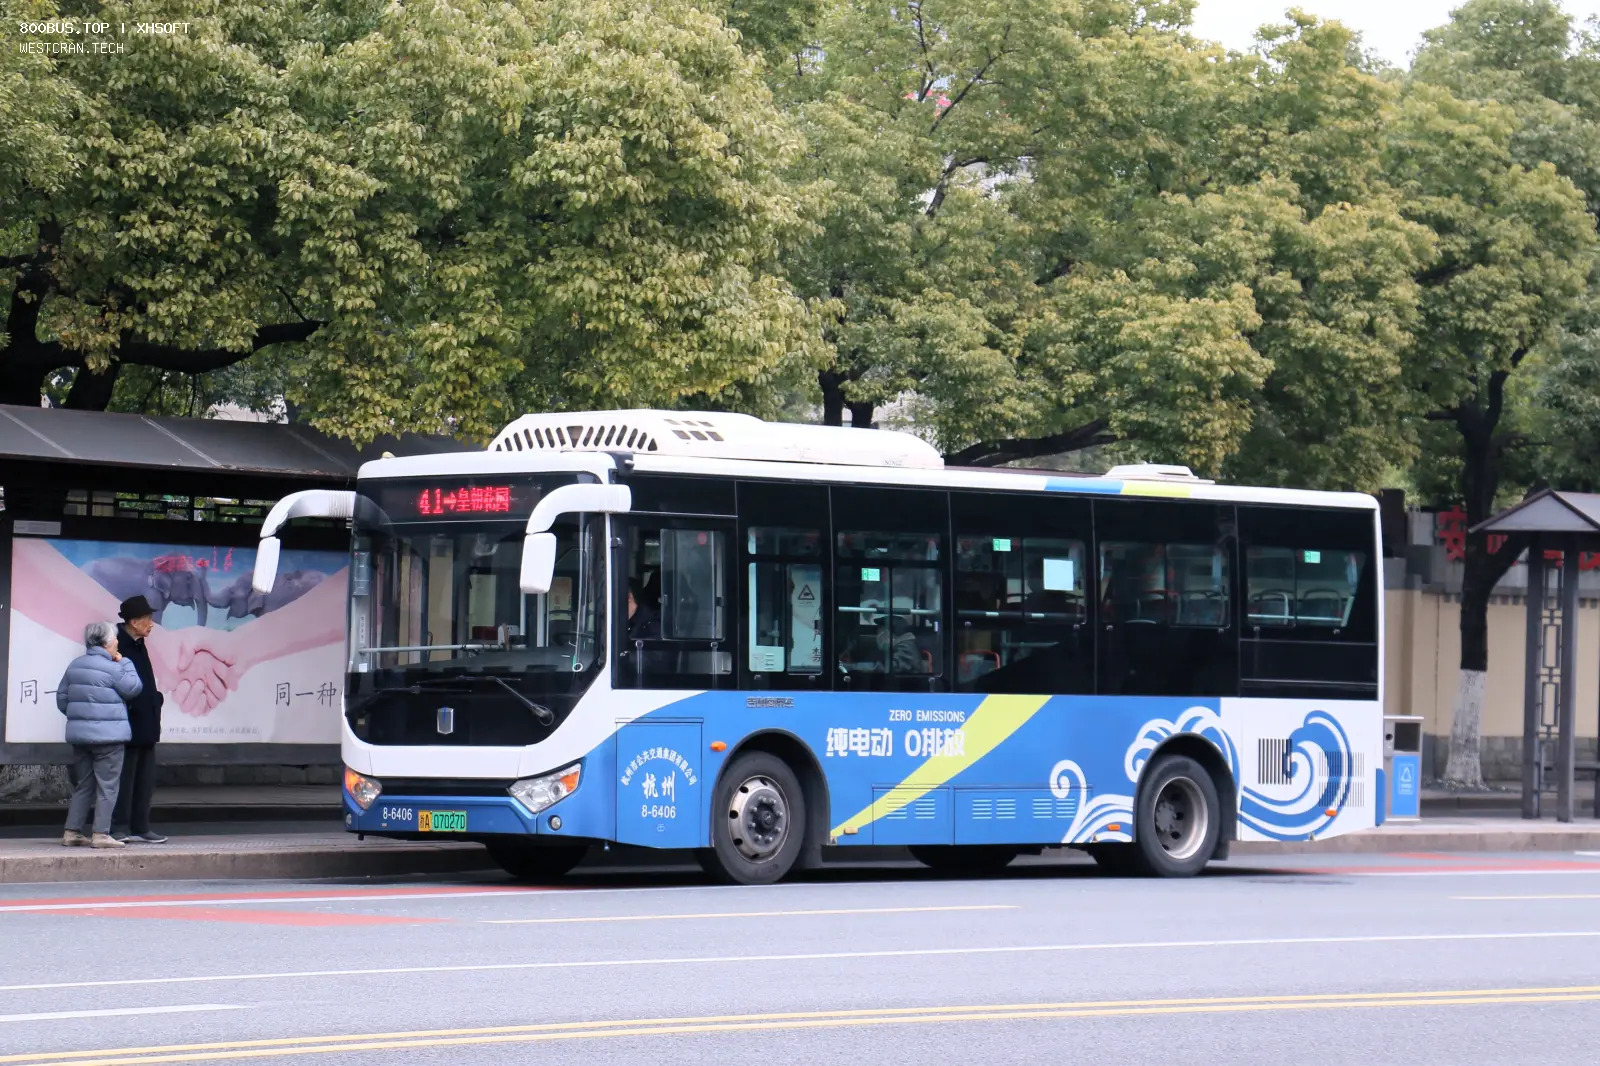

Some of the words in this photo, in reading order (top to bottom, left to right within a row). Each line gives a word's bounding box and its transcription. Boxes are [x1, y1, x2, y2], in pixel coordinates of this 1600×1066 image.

[419, 488, 443, 514] 41
[889, 709, 913, 722] ZERO
[916, 711, 966, 723] EMISSIONS
[826, 727, 893, 757] 纯电动
[620, 746, 698, 786] 杭州市公共交通集团有限公司
[641, 770, 676, 803] 杭州
[382, 807, 413, 821] 8-6406
[641, 804, 676, 819] 8-6406
